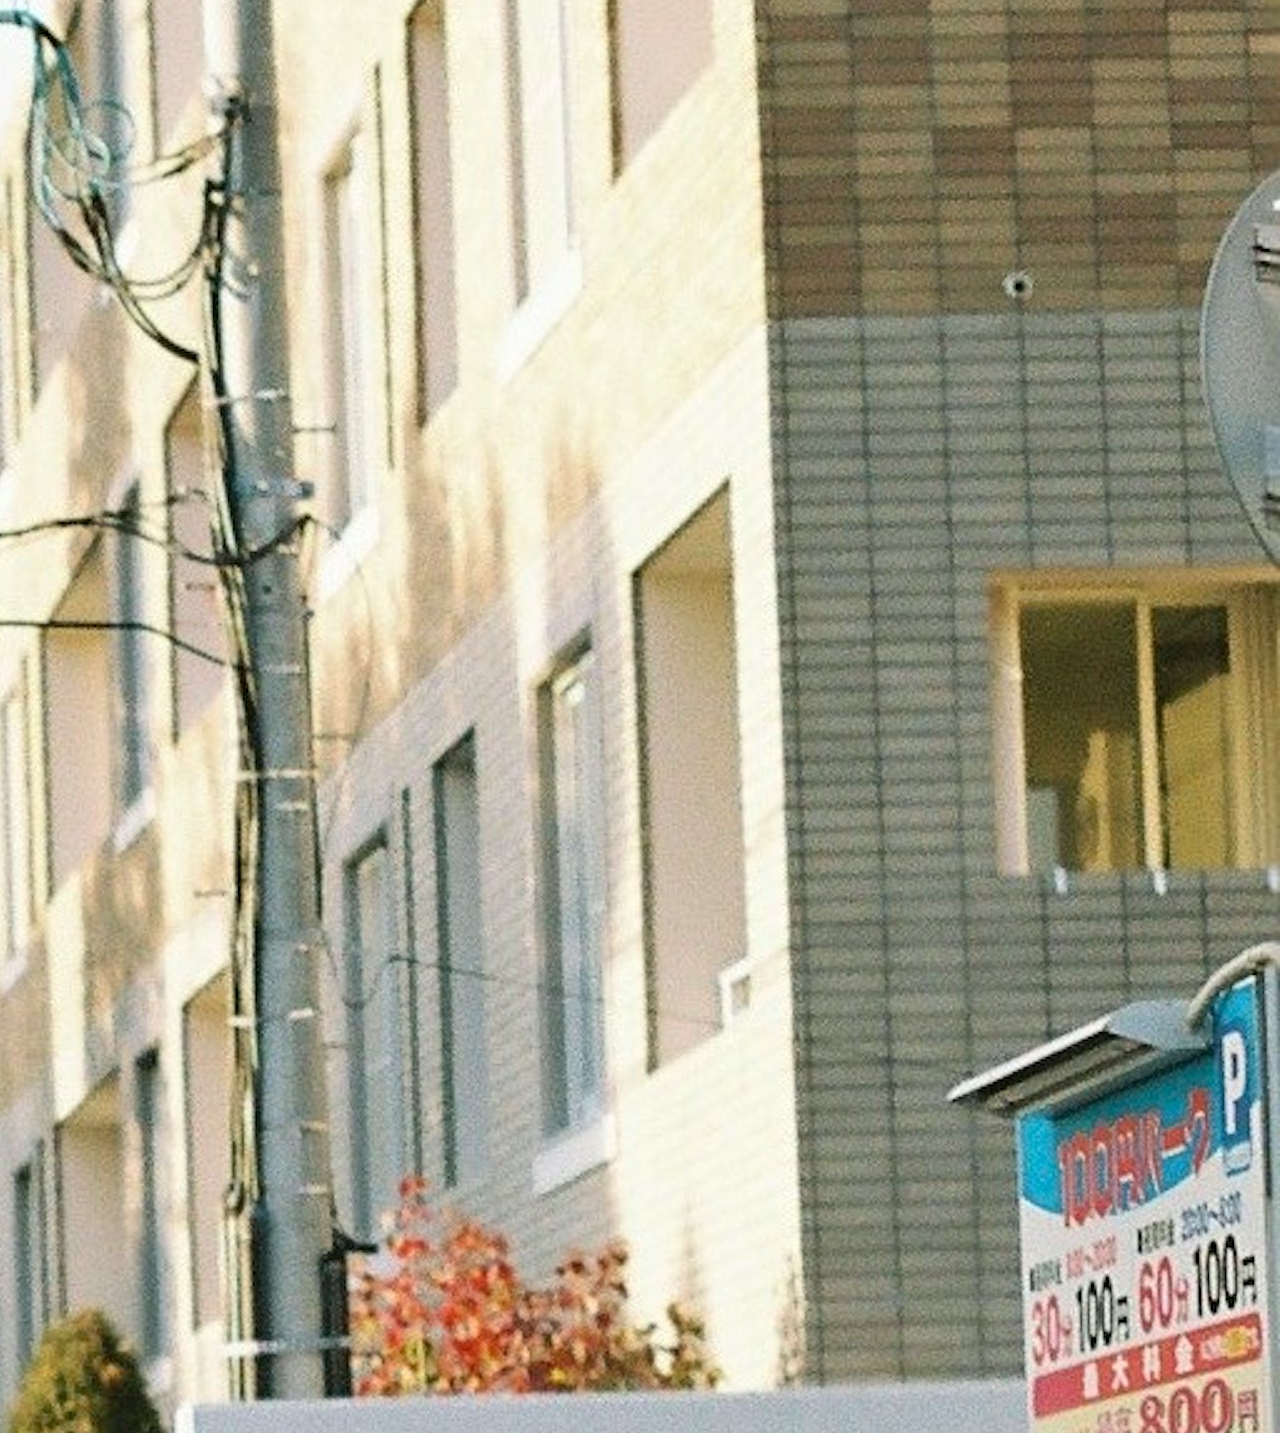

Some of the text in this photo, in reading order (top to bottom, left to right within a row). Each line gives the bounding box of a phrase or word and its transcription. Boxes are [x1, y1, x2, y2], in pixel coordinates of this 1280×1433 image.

[1222, 1031, 1246, 1135] P
[1076, 1274, 1130, 1353] 100円
[1139, 1234, 1257, 1333] 60分 100円
[1083, 1335, 1195, 1398] 最大料金
